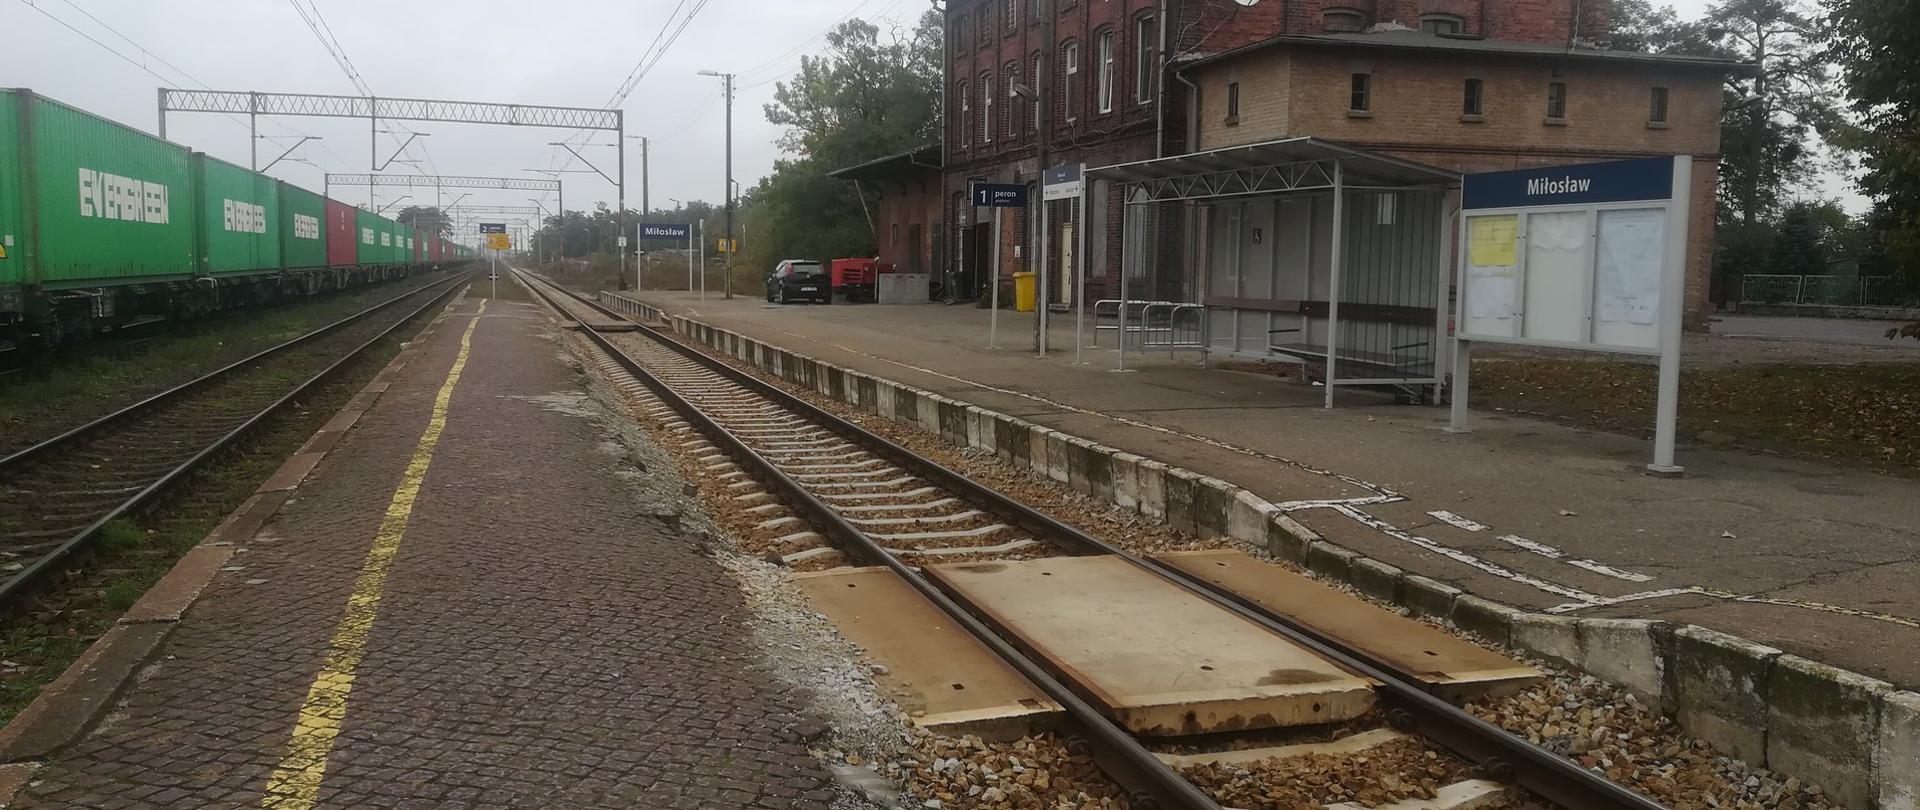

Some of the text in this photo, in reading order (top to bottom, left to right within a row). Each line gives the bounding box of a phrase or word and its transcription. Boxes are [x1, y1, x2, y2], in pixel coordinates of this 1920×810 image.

[1528, 175, 1590, 195] Miłosław
[79, 168, 168, 224] EVERGREEN
[980, 190, 986, 203] 1
